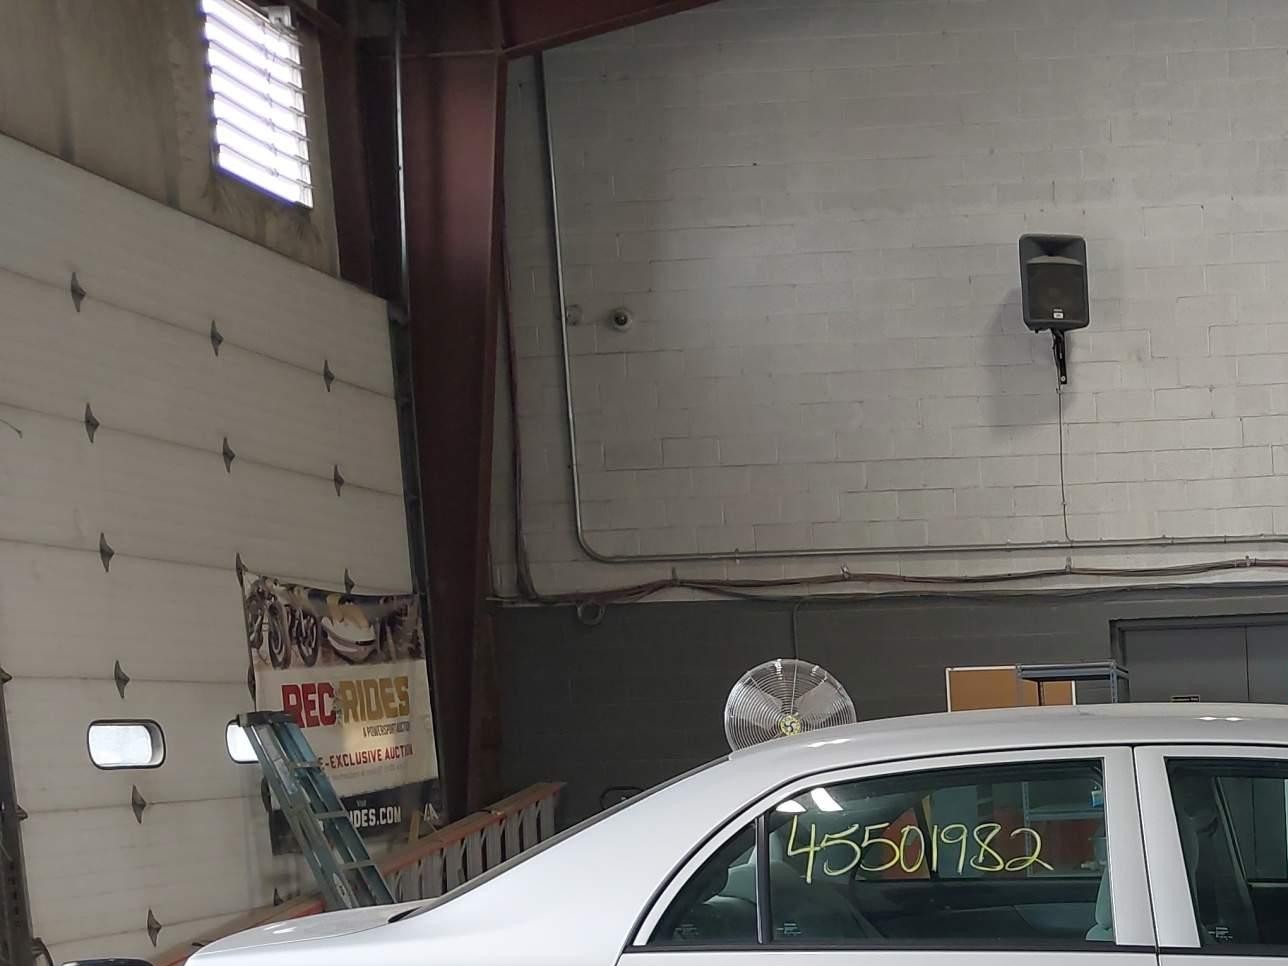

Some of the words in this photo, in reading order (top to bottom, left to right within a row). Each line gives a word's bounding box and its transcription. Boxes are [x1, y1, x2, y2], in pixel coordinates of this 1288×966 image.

[281, 682, 337, 728] REC
[339, 676, 410, 723] RIDES
[787, 814, 1054, 883] 45501982
